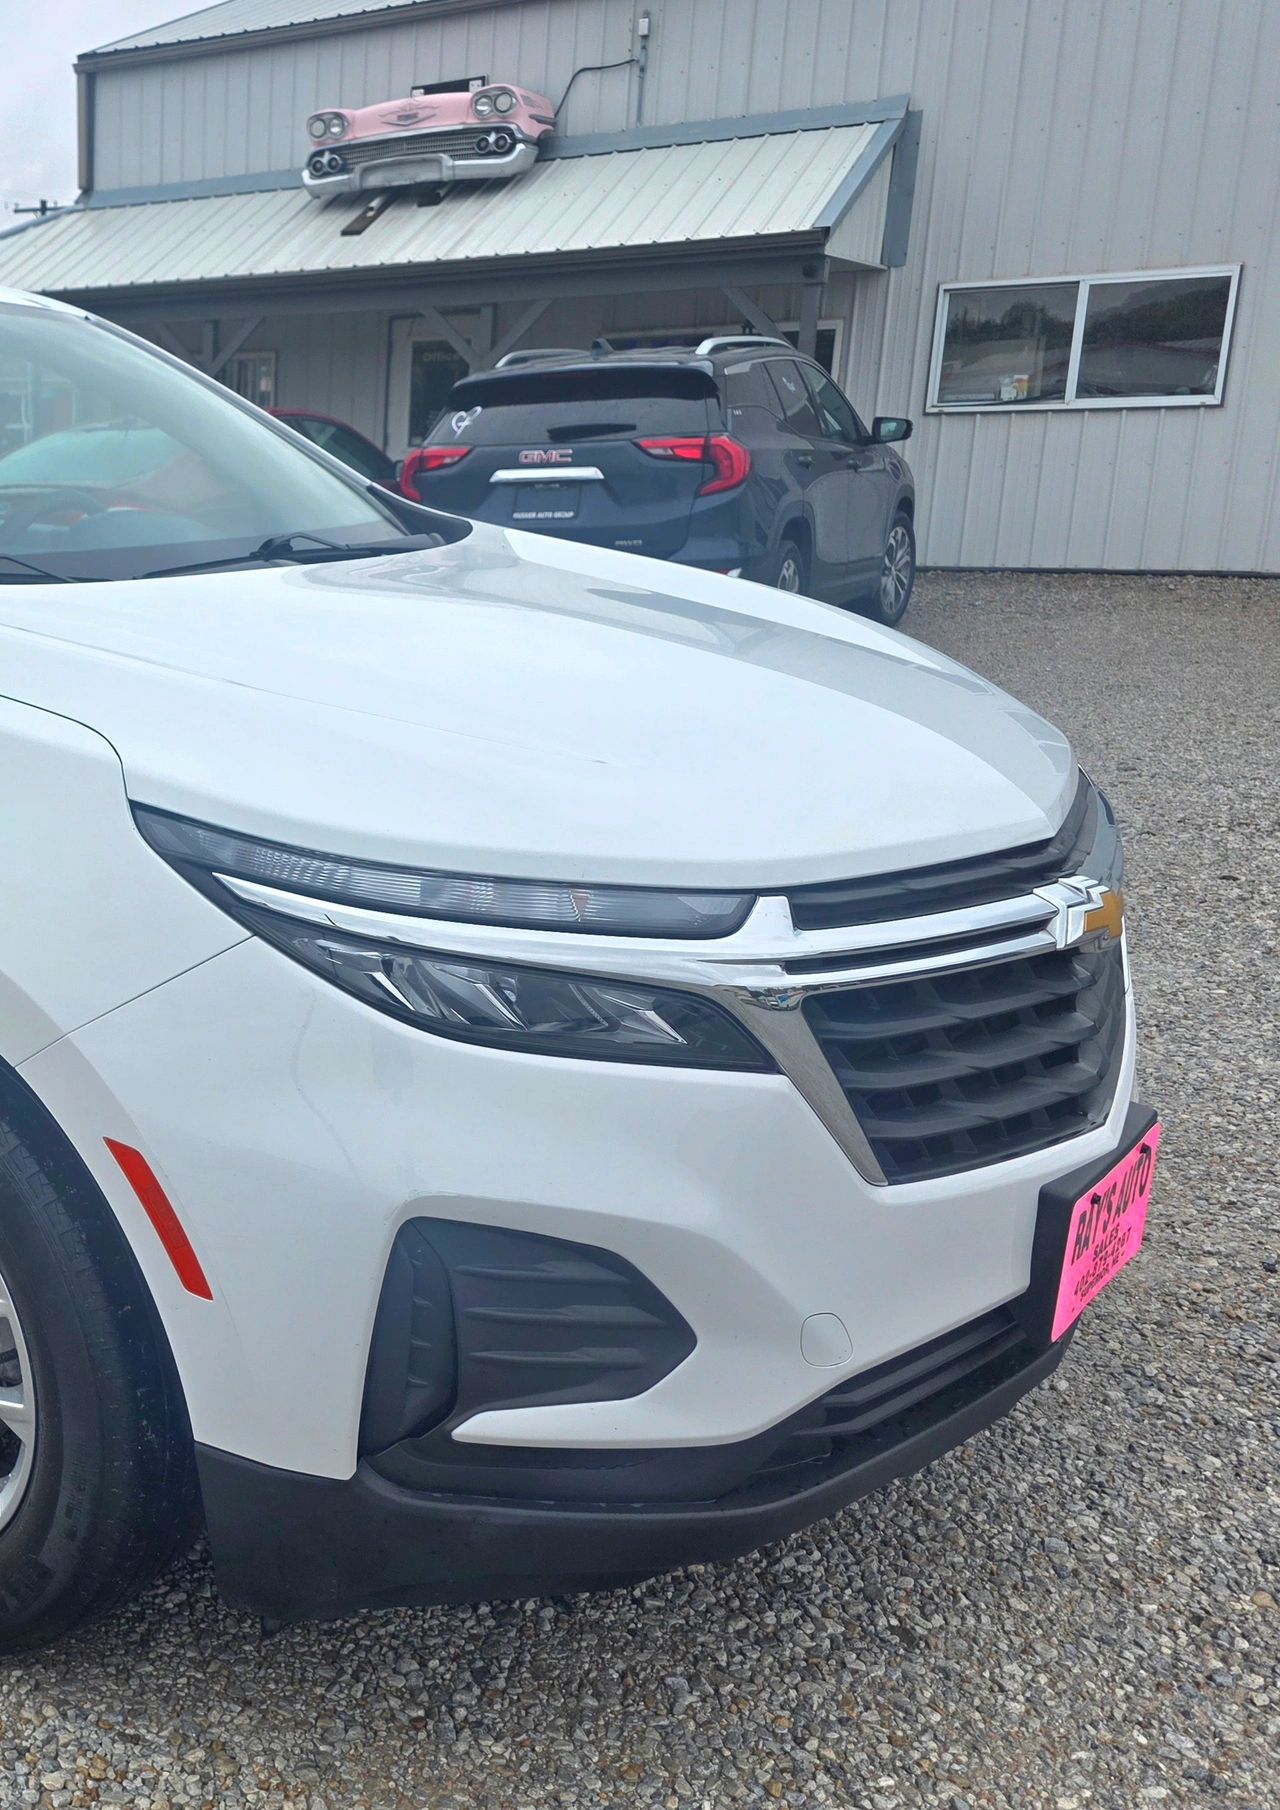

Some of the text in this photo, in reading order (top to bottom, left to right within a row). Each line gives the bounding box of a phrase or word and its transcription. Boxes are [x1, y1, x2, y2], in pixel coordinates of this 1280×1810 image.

[518, 448, 573, 464] GMC
[1071, 1150, 1152, 1266] RAY'S AUTO
[1093, 1222, 1120, 1262] SALES
